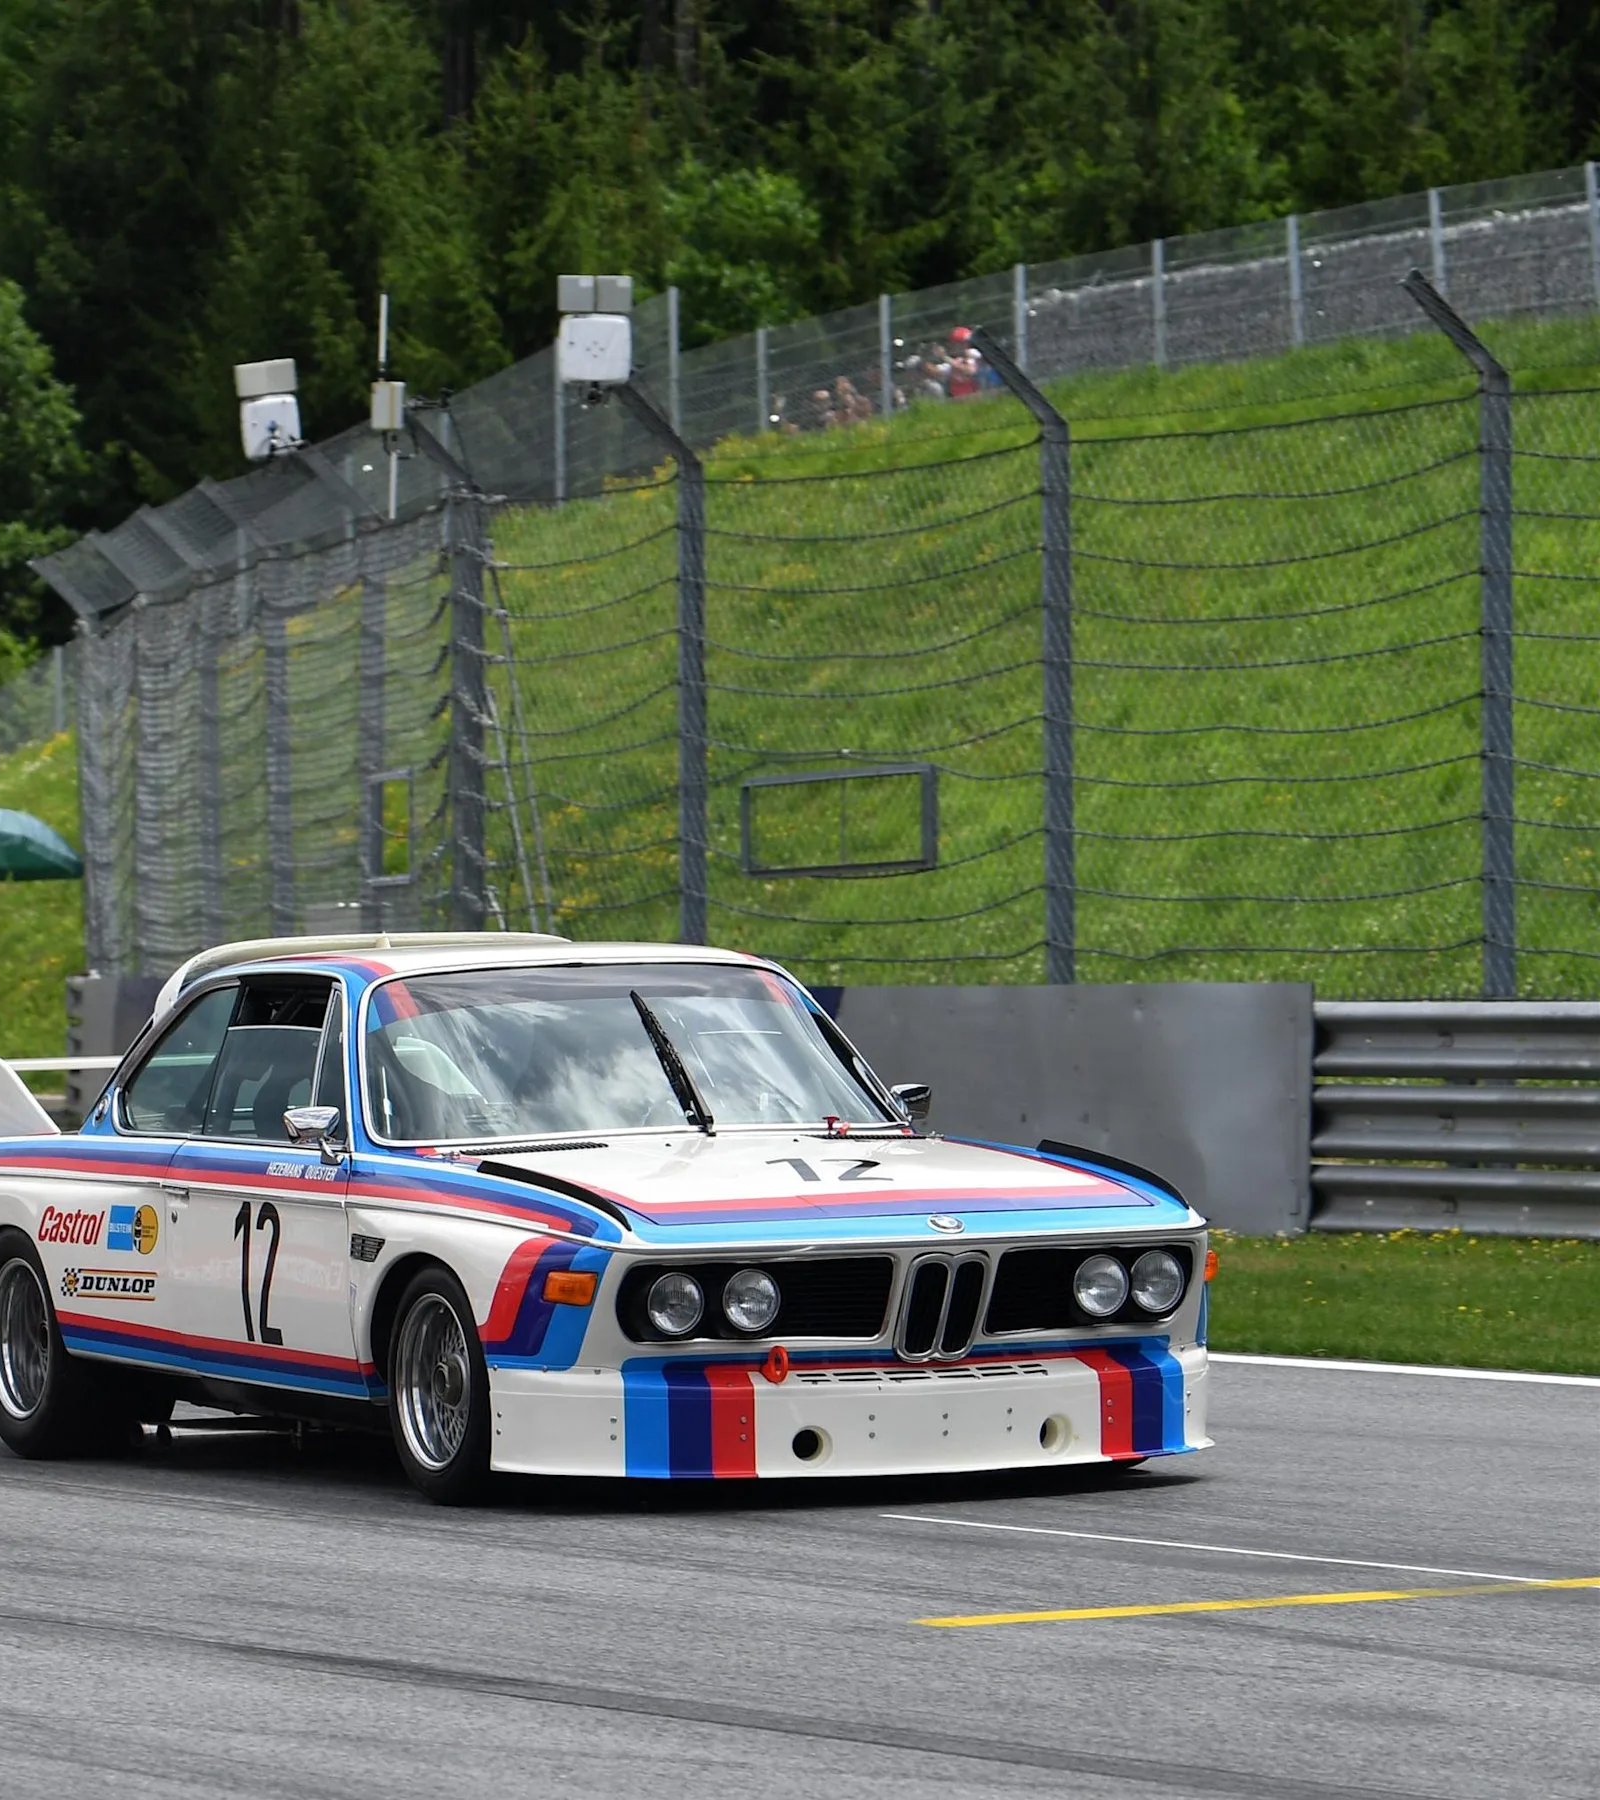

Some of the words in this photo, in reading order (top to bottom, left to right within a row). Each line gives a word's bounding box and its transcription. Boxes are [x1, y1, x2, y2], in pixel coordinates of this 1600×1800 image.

[765, 1158, 894, 1182] 12
[38, 1205, 105, 1246] Castrol
[81, 1275, 155, 1293] DUNLOP
[234, 1201, 283, 1346] 12
